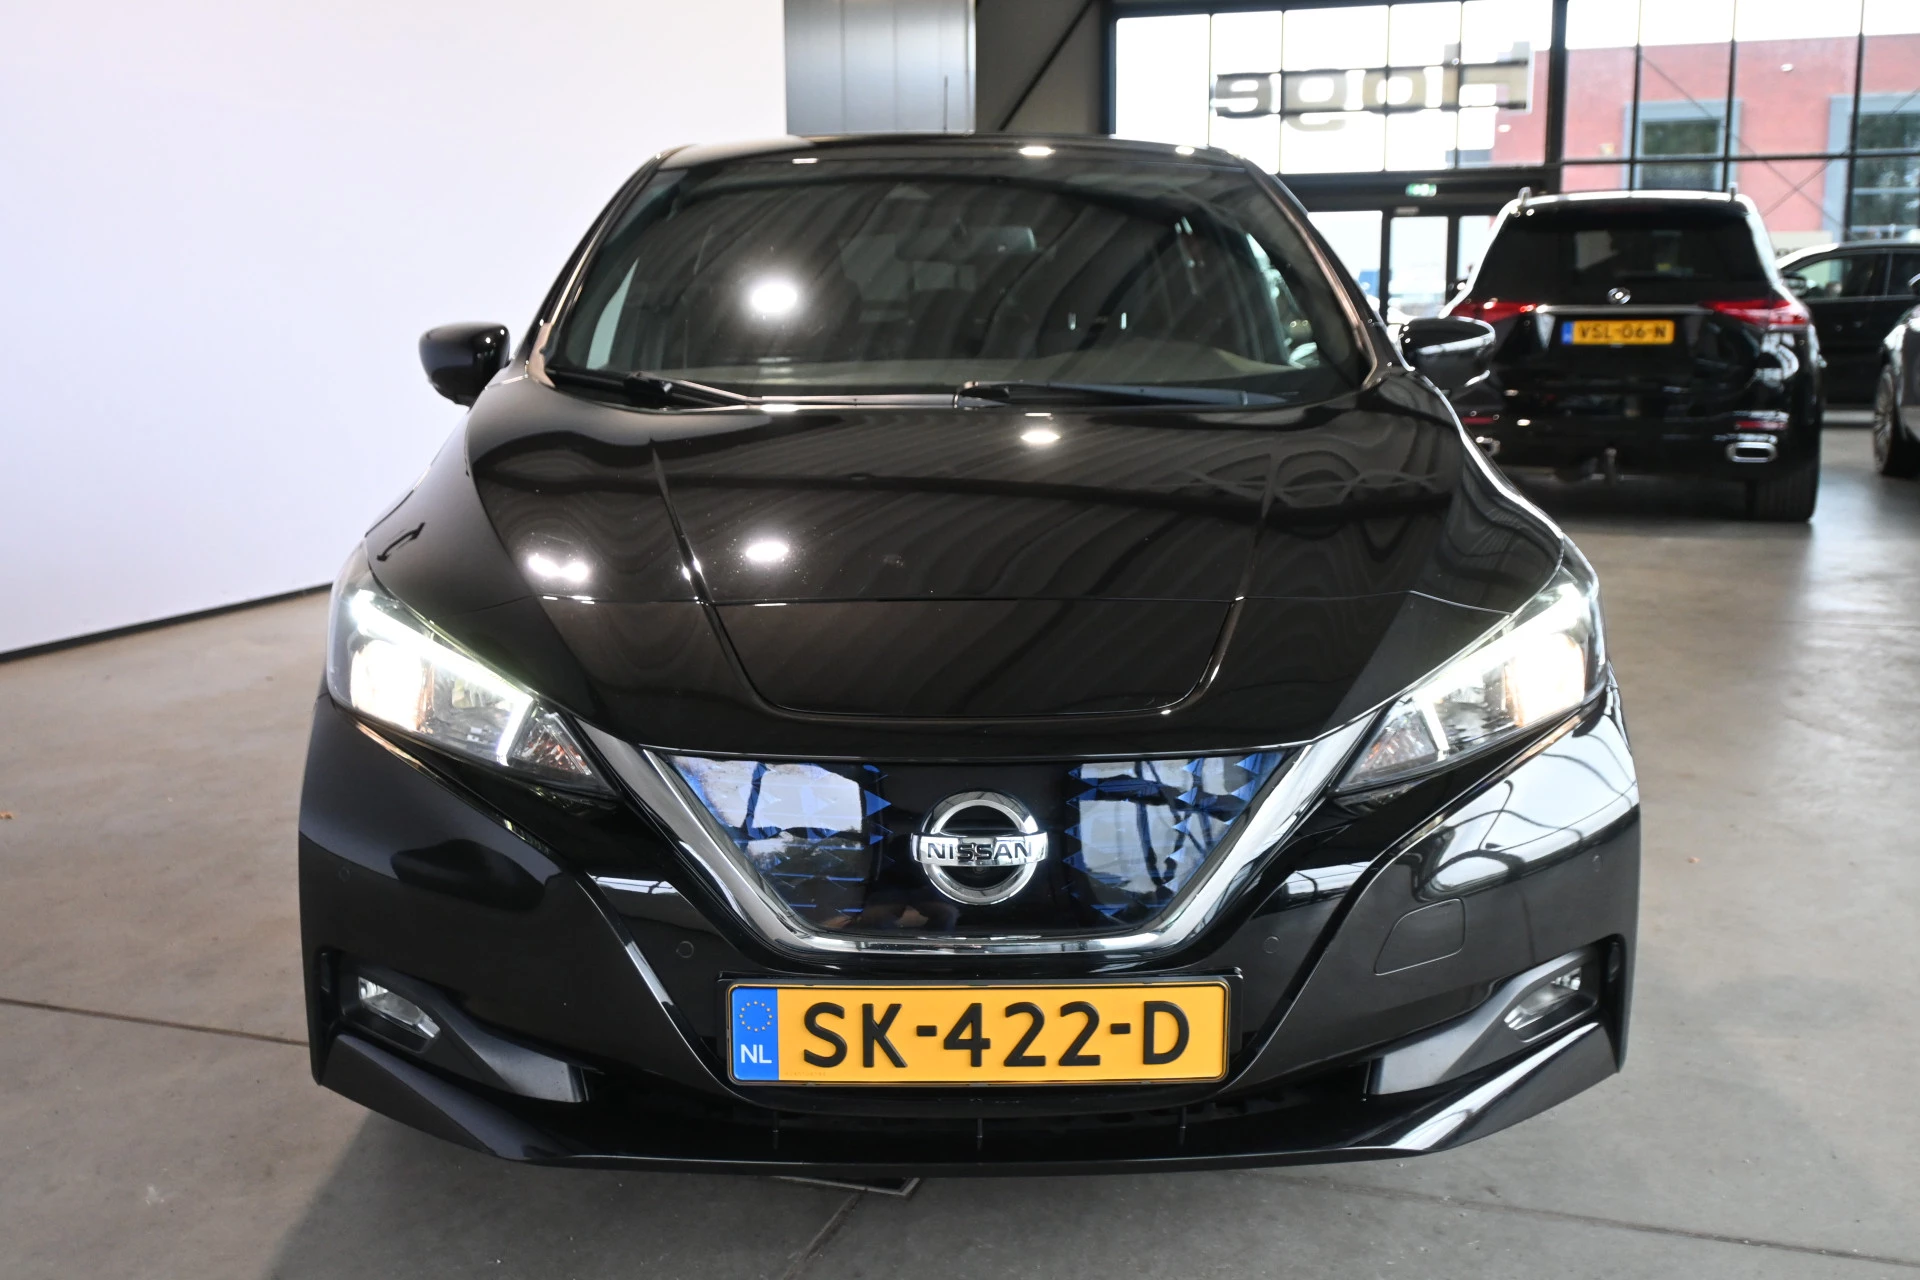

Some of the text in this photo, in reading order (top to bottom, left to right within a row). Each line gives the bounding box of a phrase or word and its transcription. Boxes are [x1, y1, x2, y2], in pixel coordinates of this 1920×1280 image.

[927, 843, 1032, 862] NISSAN
[803, 1001, 1190, 1068] SK-422-D
[741, 1044, 772, 1063] NL
